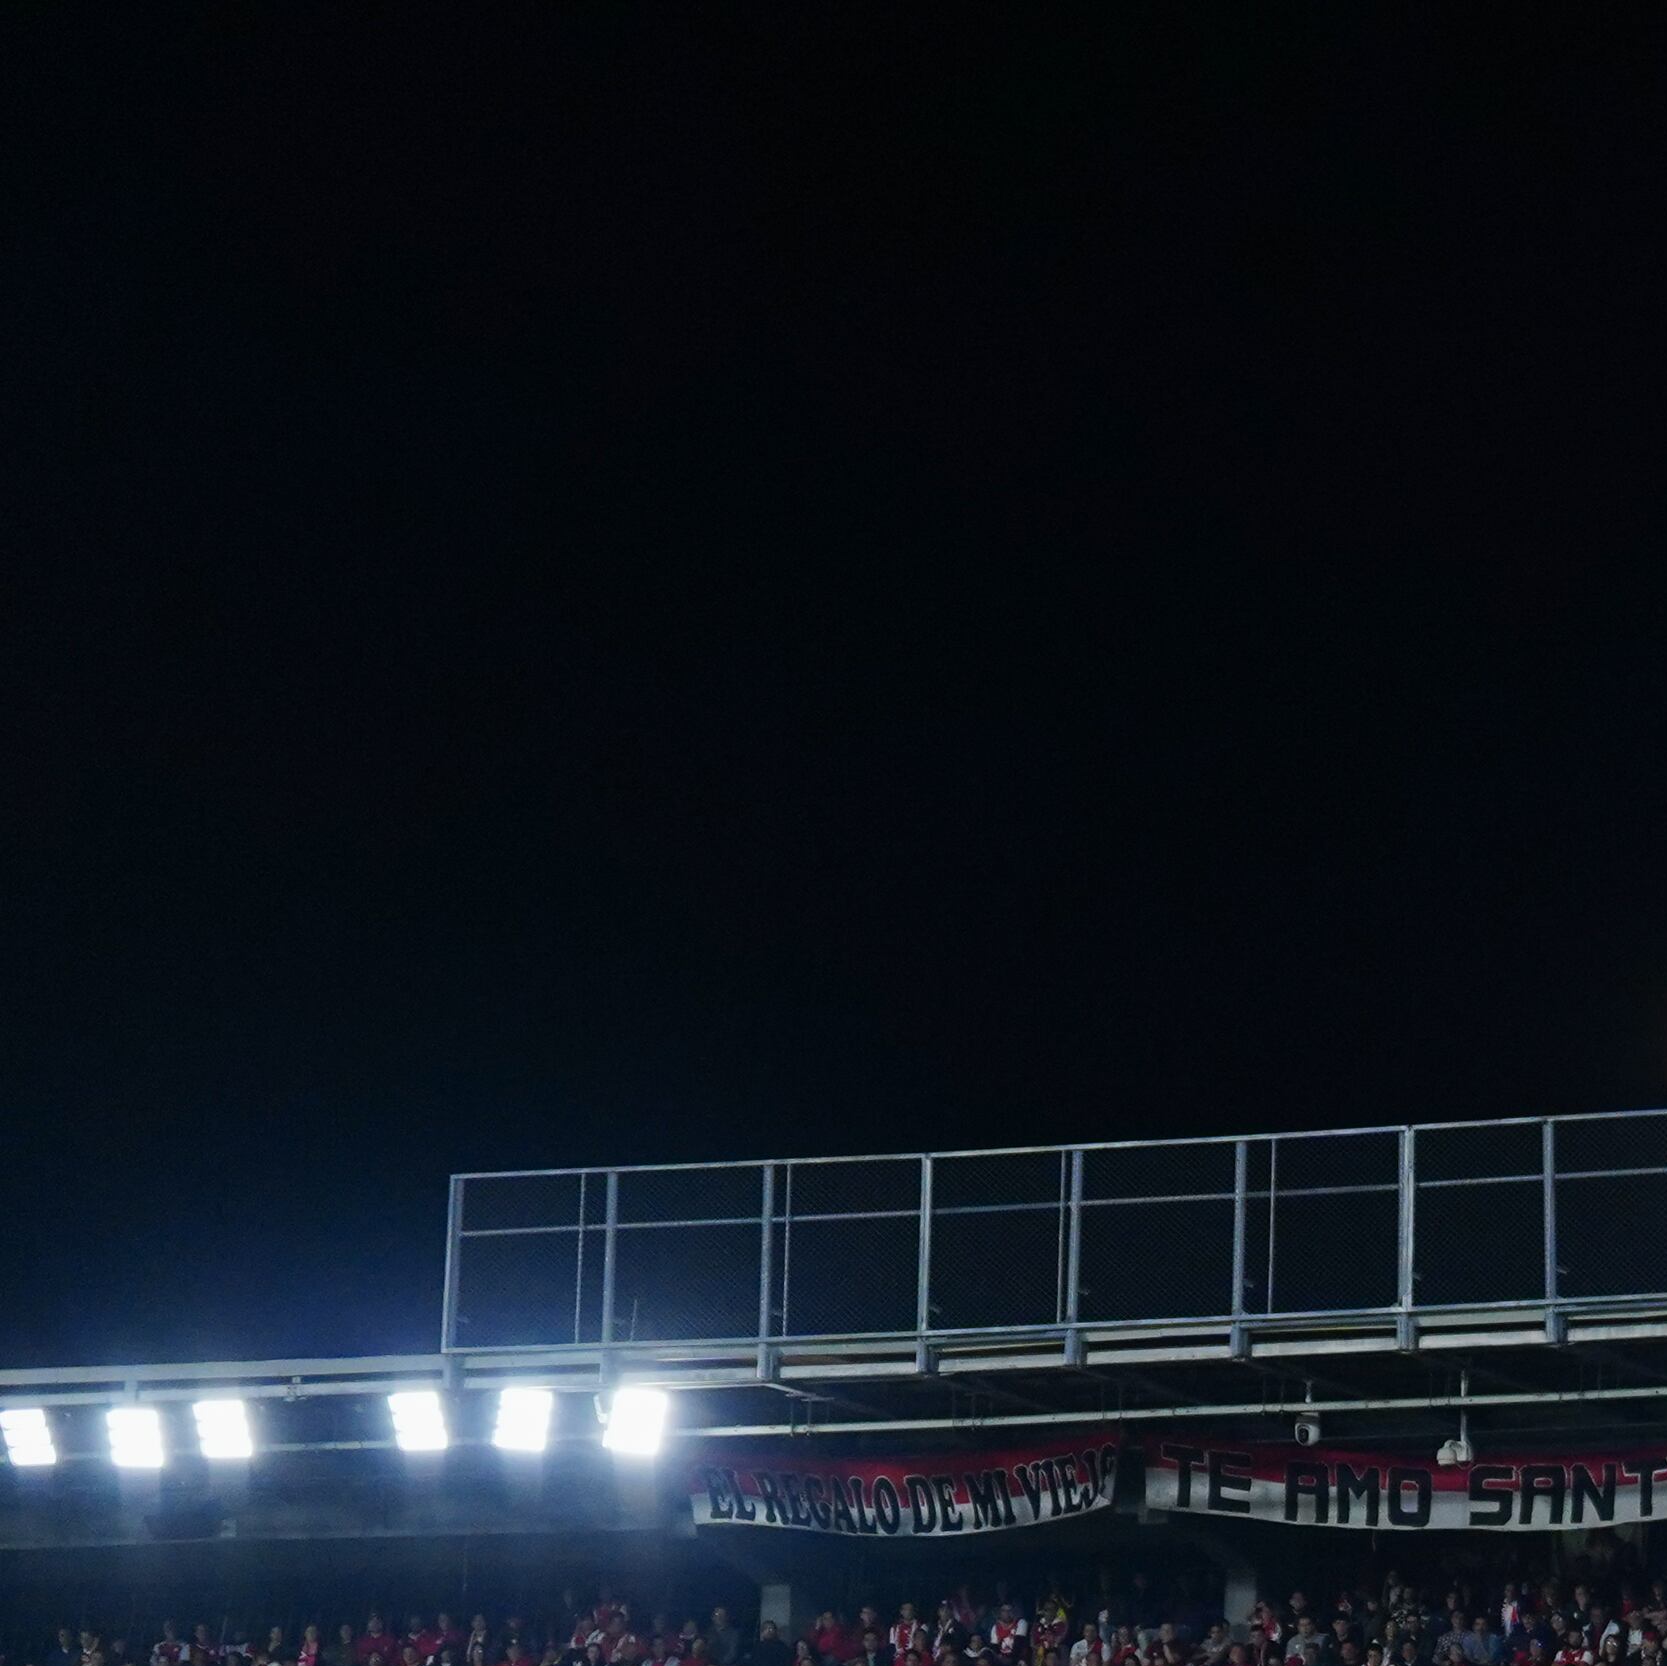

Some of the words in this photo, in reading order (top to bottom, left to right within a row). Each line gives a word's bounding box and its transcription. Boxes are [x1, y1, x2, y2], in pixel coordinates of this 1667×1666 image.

[710, 1468, 757, 1521] EL
[755, 1471, 901, 1534] REGALO
[905, 1474, 964, 1534] DE
[966, 1470, 1016, 1530] MI
[1160, 1442, 1252, 1513] TE
[1283, 1463, 1431, 1527] AMO
